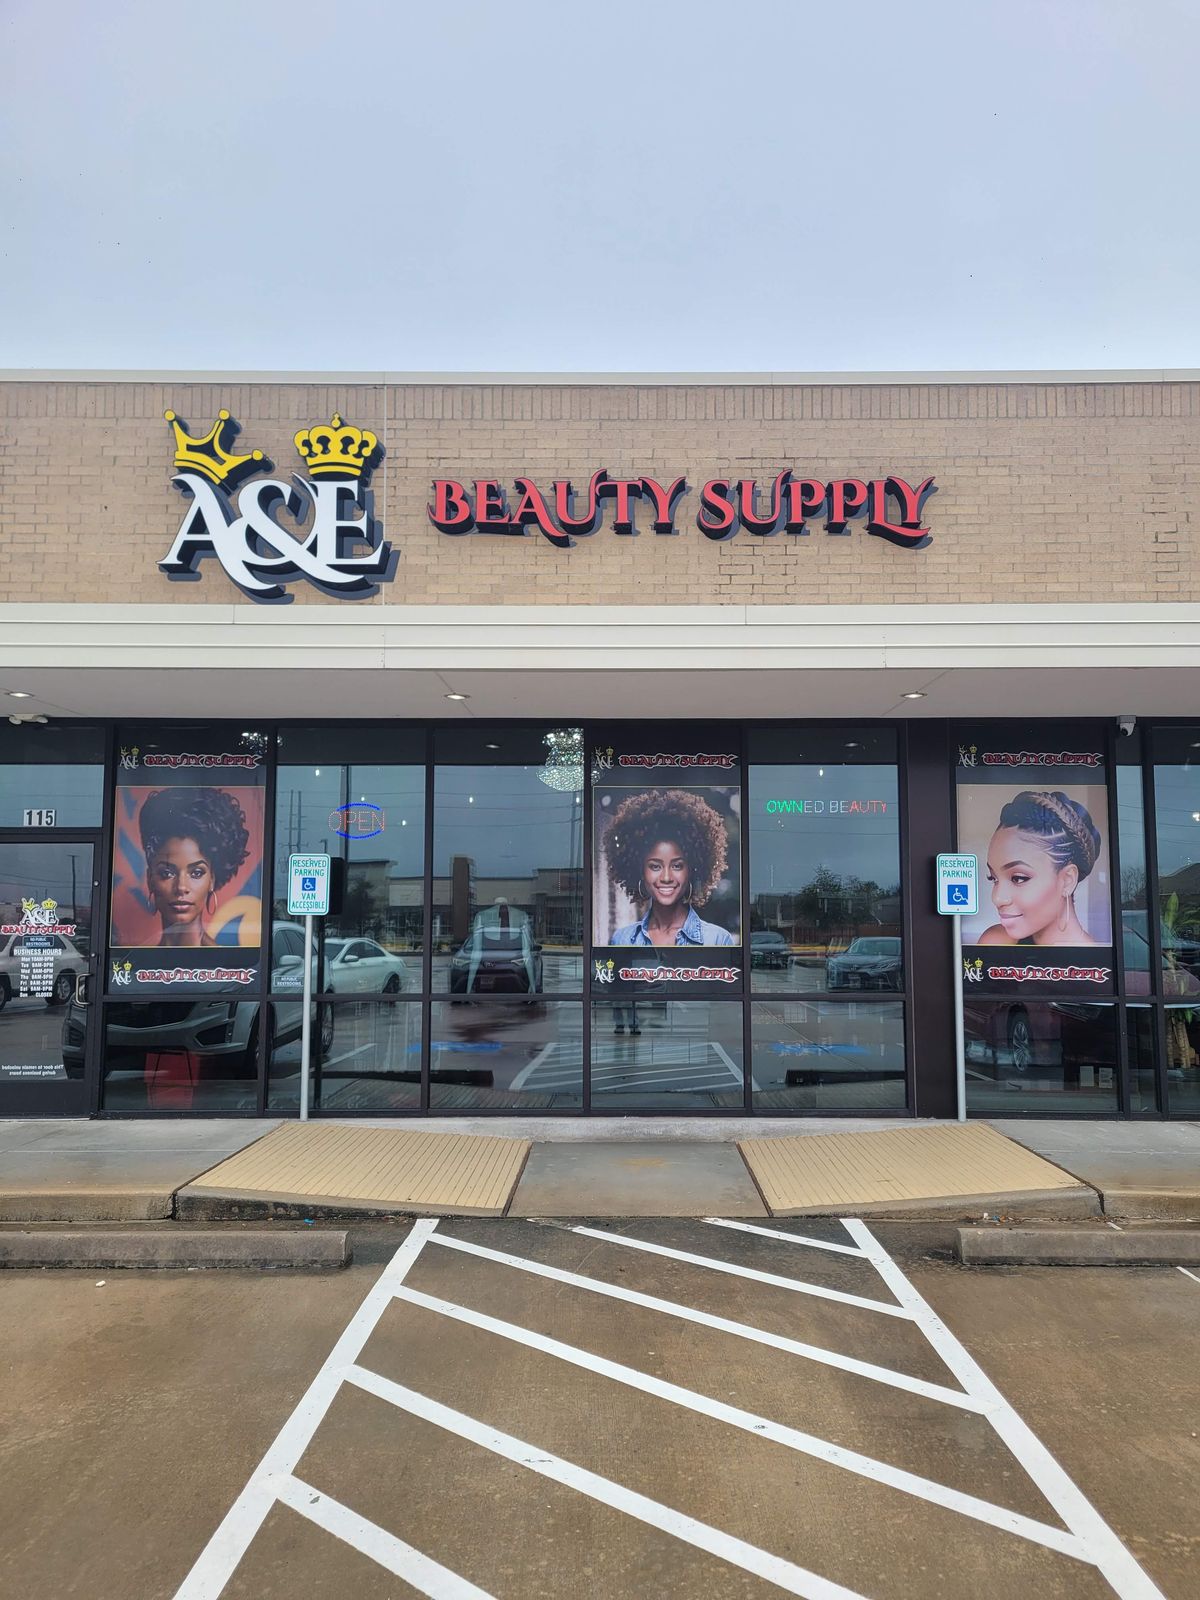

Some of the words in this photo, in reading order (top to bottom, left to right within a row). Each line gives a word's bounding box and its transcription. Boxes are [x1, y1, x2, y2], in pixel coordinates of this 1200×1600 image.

[155, 472, 385, 591] A&E
[427, 468, 687, 542] BEAUTY
[699, 468, 936, 543] SUPPLY
[119, 755, 140, 769] A&E
[144, 753, 201, 768] BEAUTY
[203, 753, 260, 769] SUPPLY
[595, 755, 614, 769] A&E
[619, 753, 678, 768] BEAUTY
[679, 753, 737, 769] SUPPLY
[958, 753, 978, 767] A&E
[983, 752, 1042, 767] BEAUTY
[1043, 752, 1101, 767] SUPPLY
[766, 800, 823, 814] OWNED
[829, 800, 887, 814] BEAUTY
[26, 810, 54, 826] 115
[328, 811, 385, 831] OPEN
[292, 859, 326, 868] RESERVED
[940, 860, 975, 868] RESERVED
[294, 869, 325, 877] PARKING
[943, 870, 973, 878] PARKING
[291, 901, 325, 909] ACCESSIBLE
[20, 908, 58, 927] A&E
[1, 925, 39, 936] BEAUTY
[39, 925, 76, 936] SUPPLY
[14, 948, 41, 956] BUSINESS
[43, 948, 62, 956] HOURS
[111, 970, 132, 985] A&E
[136, 968, 197, 983] BEAUTY
[197, 968, 256, 984] SUPPLY
[594, 968, 615, 983] A&E
[619, 966, 681, 982] BEAUTY
[681, 966, 740, 982] SUPPLY
[963, 967, 984, 982] A&E
[988, 966, 1050, 981] BEAUTY
[1050, 966, 1110, 982] SUPPLY
